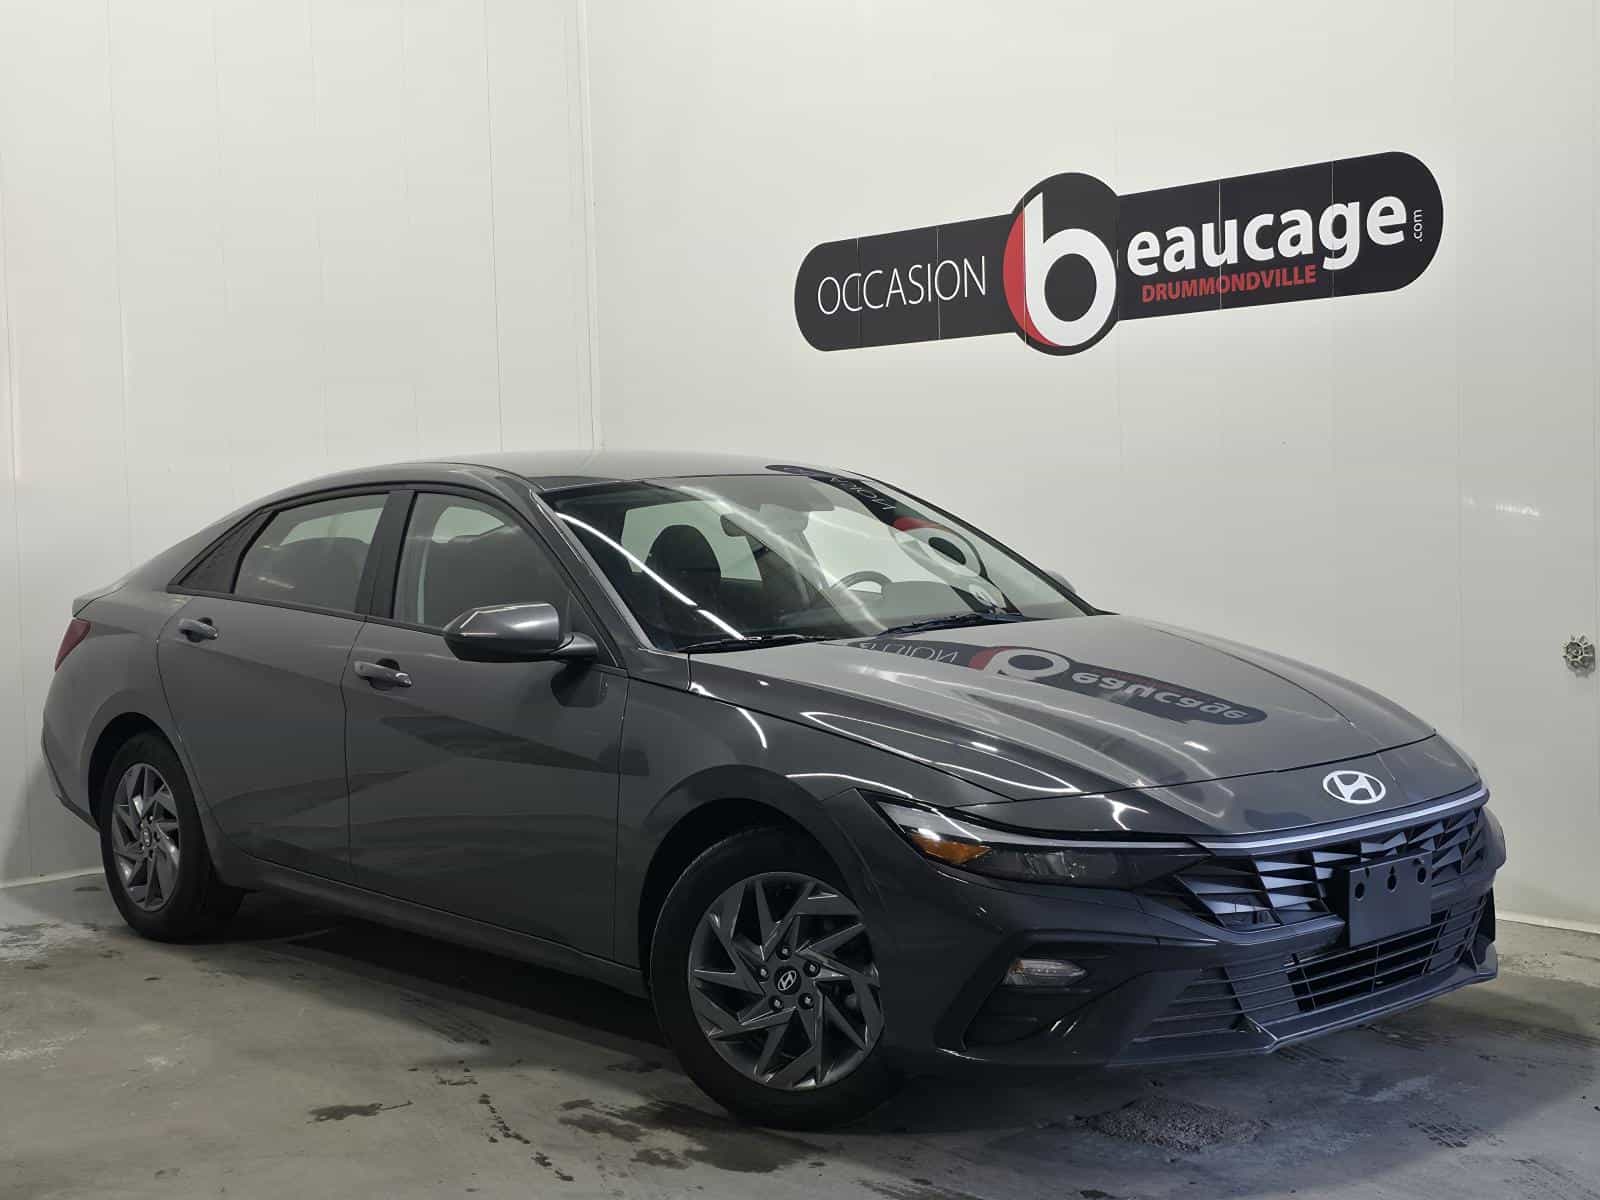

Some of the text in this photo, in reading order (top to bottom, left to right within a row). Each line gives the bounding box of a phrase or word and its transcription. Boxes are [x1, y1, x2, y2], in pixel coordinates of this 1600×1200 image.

[817, 255, 987, 316] OCCASION
[1413, 209, 1423, 243] .com
[1142, 264, 1317, 303] DRUMMONDVILLE
